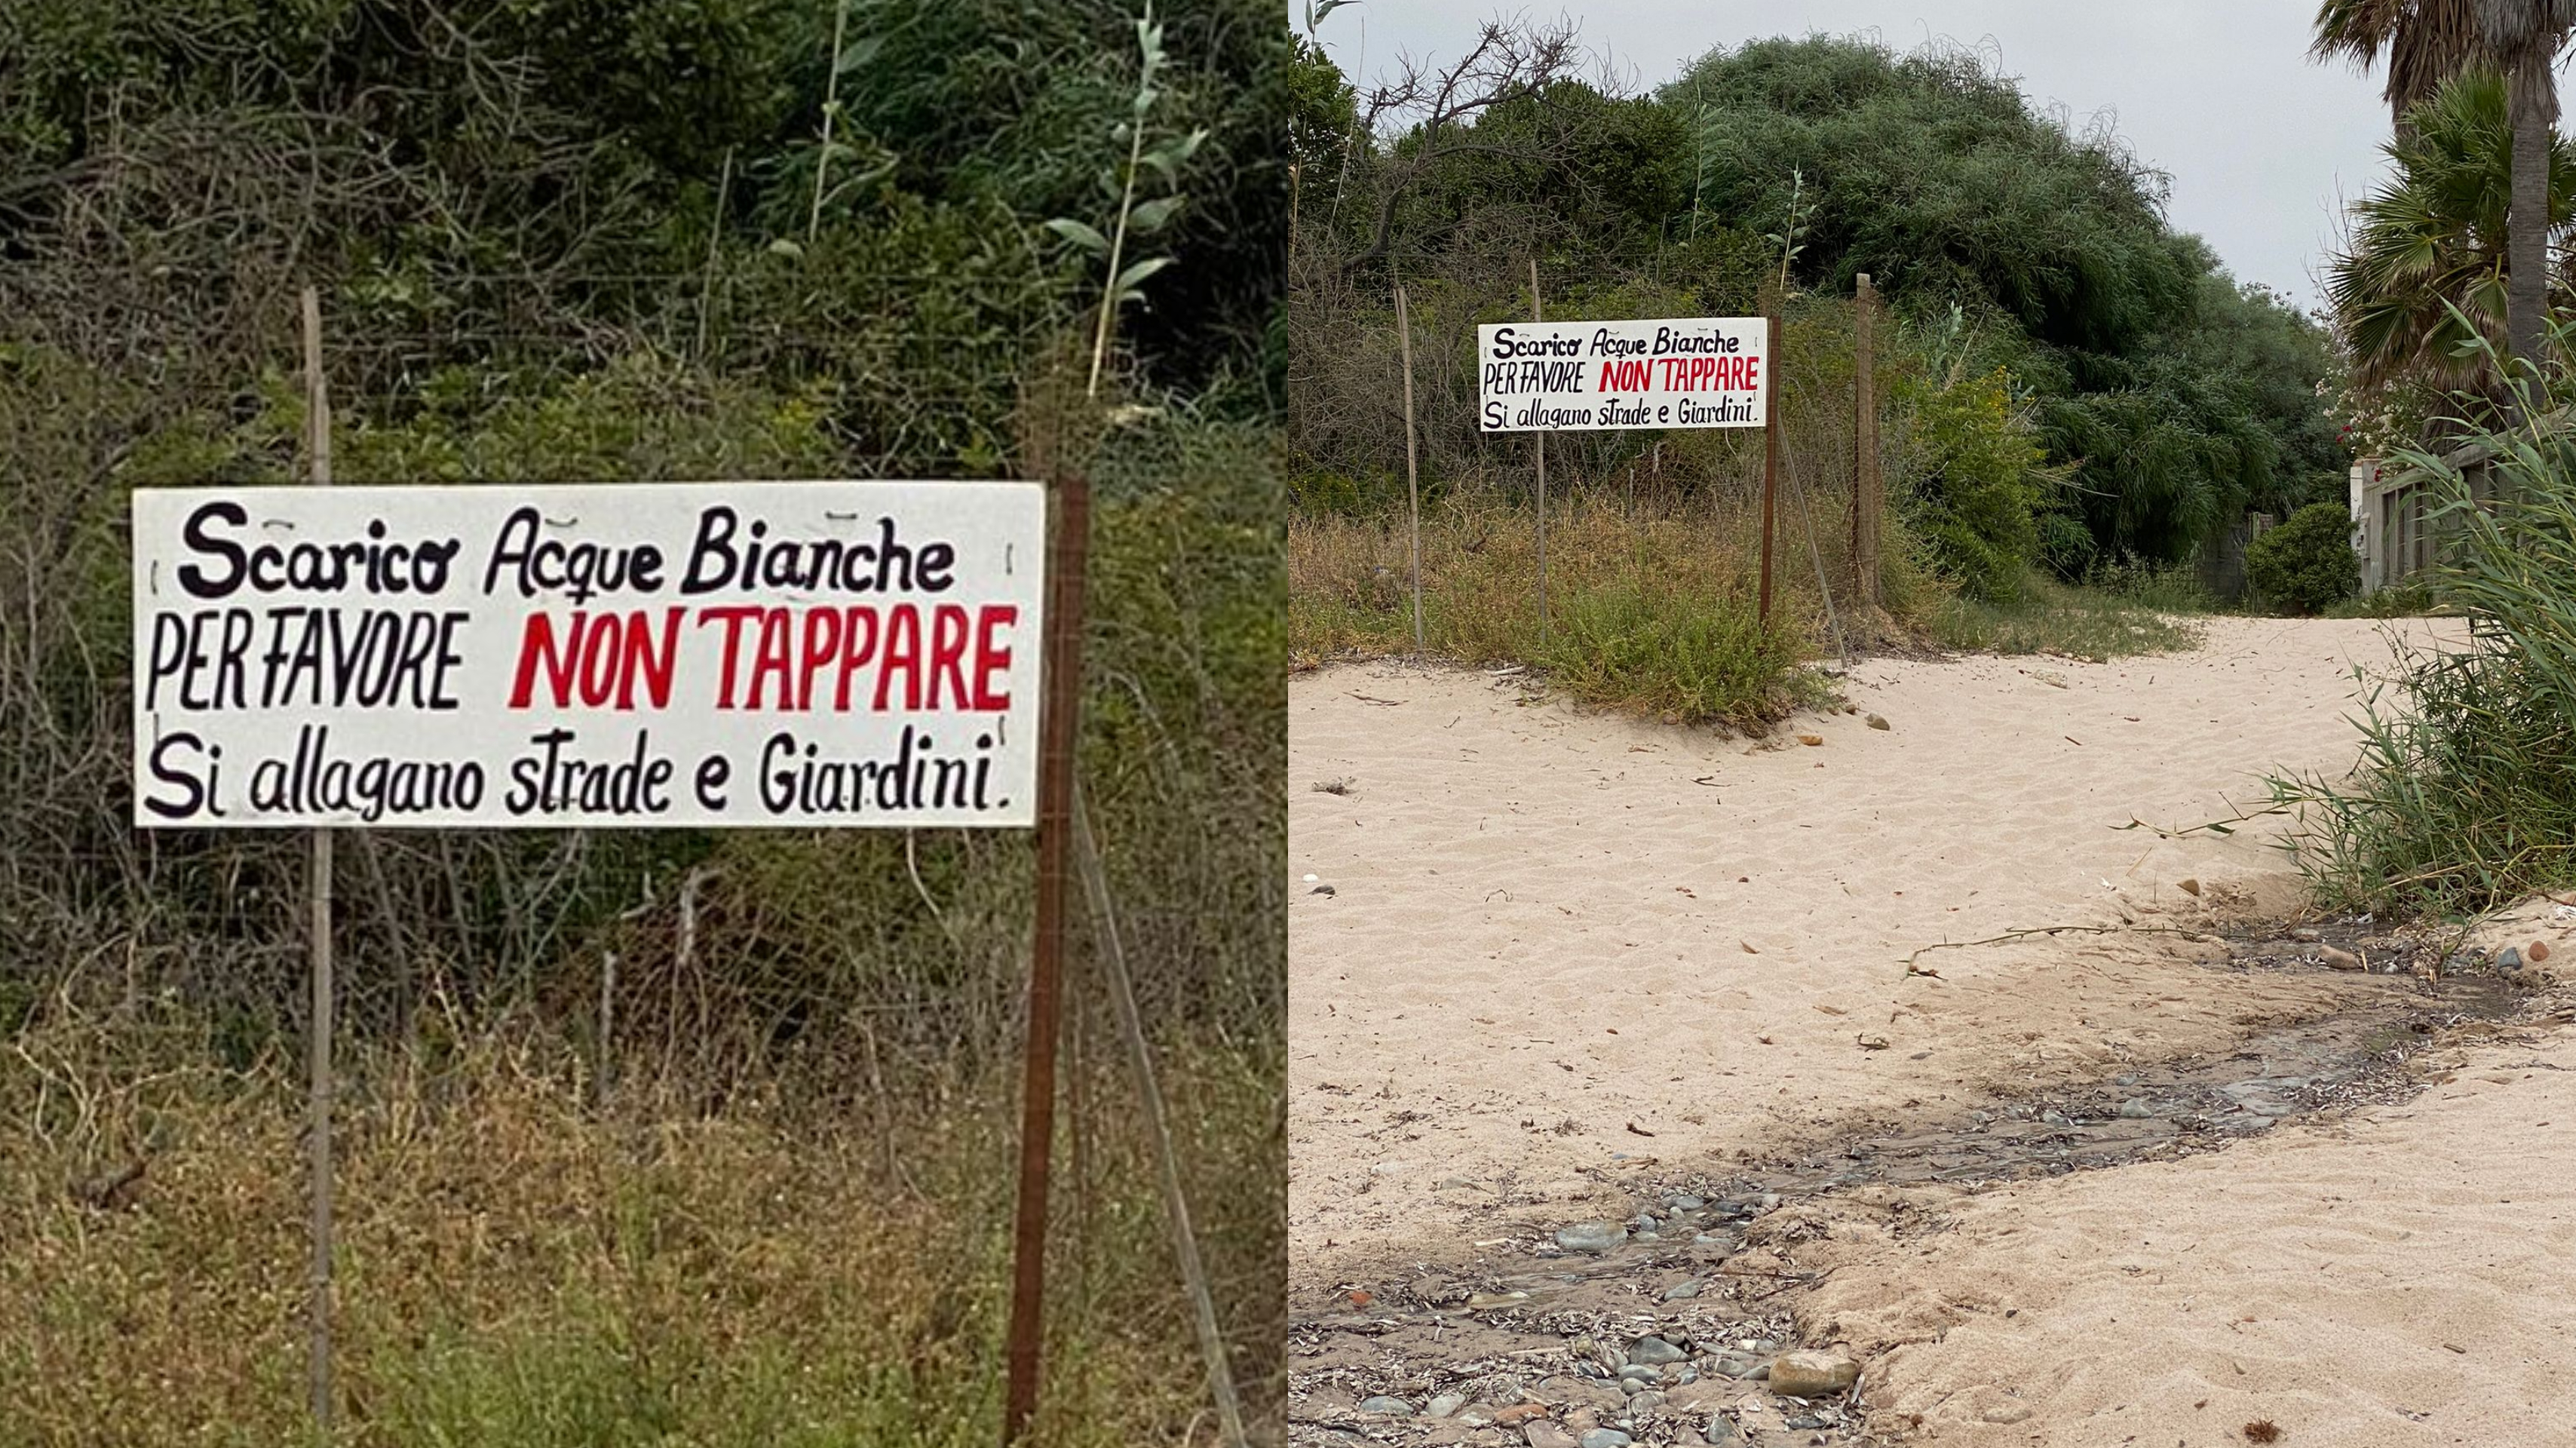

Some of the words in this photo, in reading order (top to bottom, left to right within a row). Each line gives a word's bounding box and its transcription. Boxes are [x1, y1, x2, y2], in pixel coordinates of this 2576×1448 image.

[1493, 328, 1583, 359] Scarico
[1590, 327, 1648, 359] Acque
[1651, 327, 1739, 356] Bianche
[1598, 357, 1654, 393] NON
[1658, 356, 1759, 391] TAPPARE
[1483, 400, 1508, 429] Si
[1516, 398, 1592, 429] allagano
[1597, 397, 1651, 427] strade
[1657, 403, 1670, 423] e
[1678, 394, 1759, 424] Giardini.
[178, 502, 462, 597] Scarico
[483, 506, 665, 605] Acque
[680, 505, 955, 596] Bianche
[508, 606, 688, 710] NON
[698, 605, 1017, 712] TAPPARE
[145, 732, 223, 818] Si
[249, 726, 484, 822] allagano
[505, 727, 671, 814] strade
[695, 753, 728, 807] e
[759, 724, 1011, 813] Giardini.
